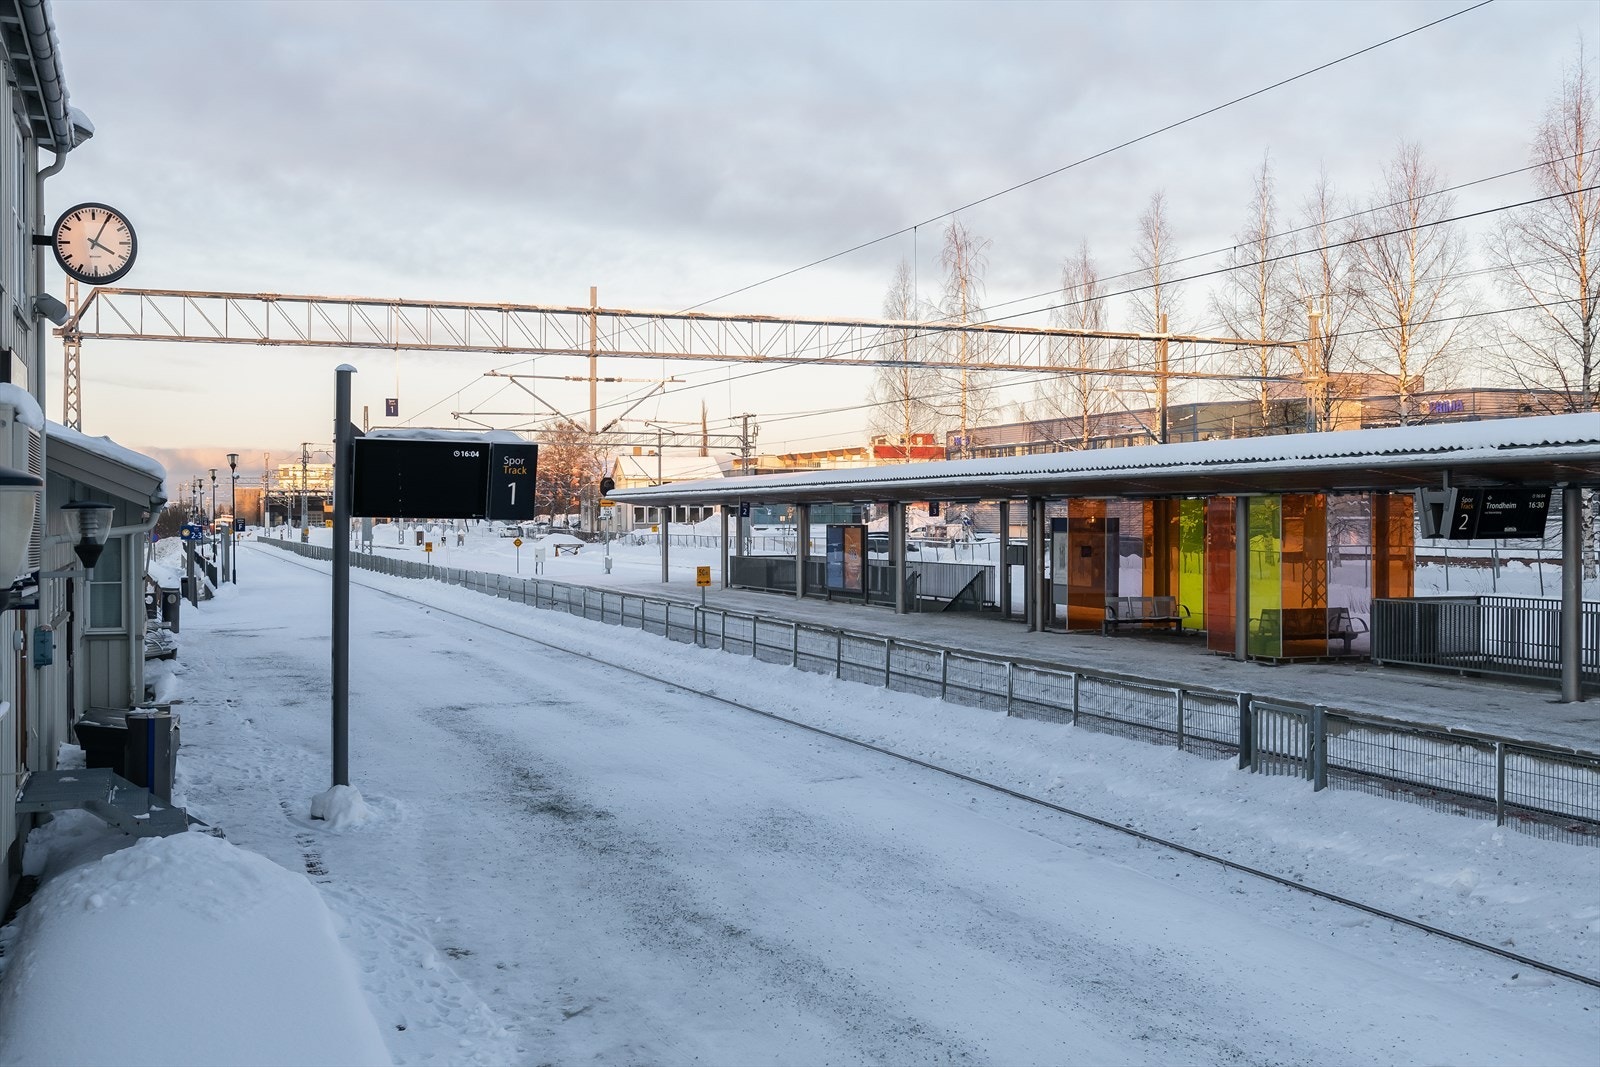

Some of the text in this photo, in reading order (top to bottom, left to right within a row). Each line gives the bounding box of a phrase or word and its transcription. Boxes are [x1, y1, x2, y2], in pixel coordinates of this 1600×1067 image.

[460, 450, 480, 458] 16:04
[503, 455, 525, 467] Spor
[503, 465, 527, 475] Track
[507, 482, 517, 506] 1
[1460, 502, 1474, 510] Track
[1486, 501, 1545, 509] Trondheim 16:30
[1458, 513, 1469, 530] 2
